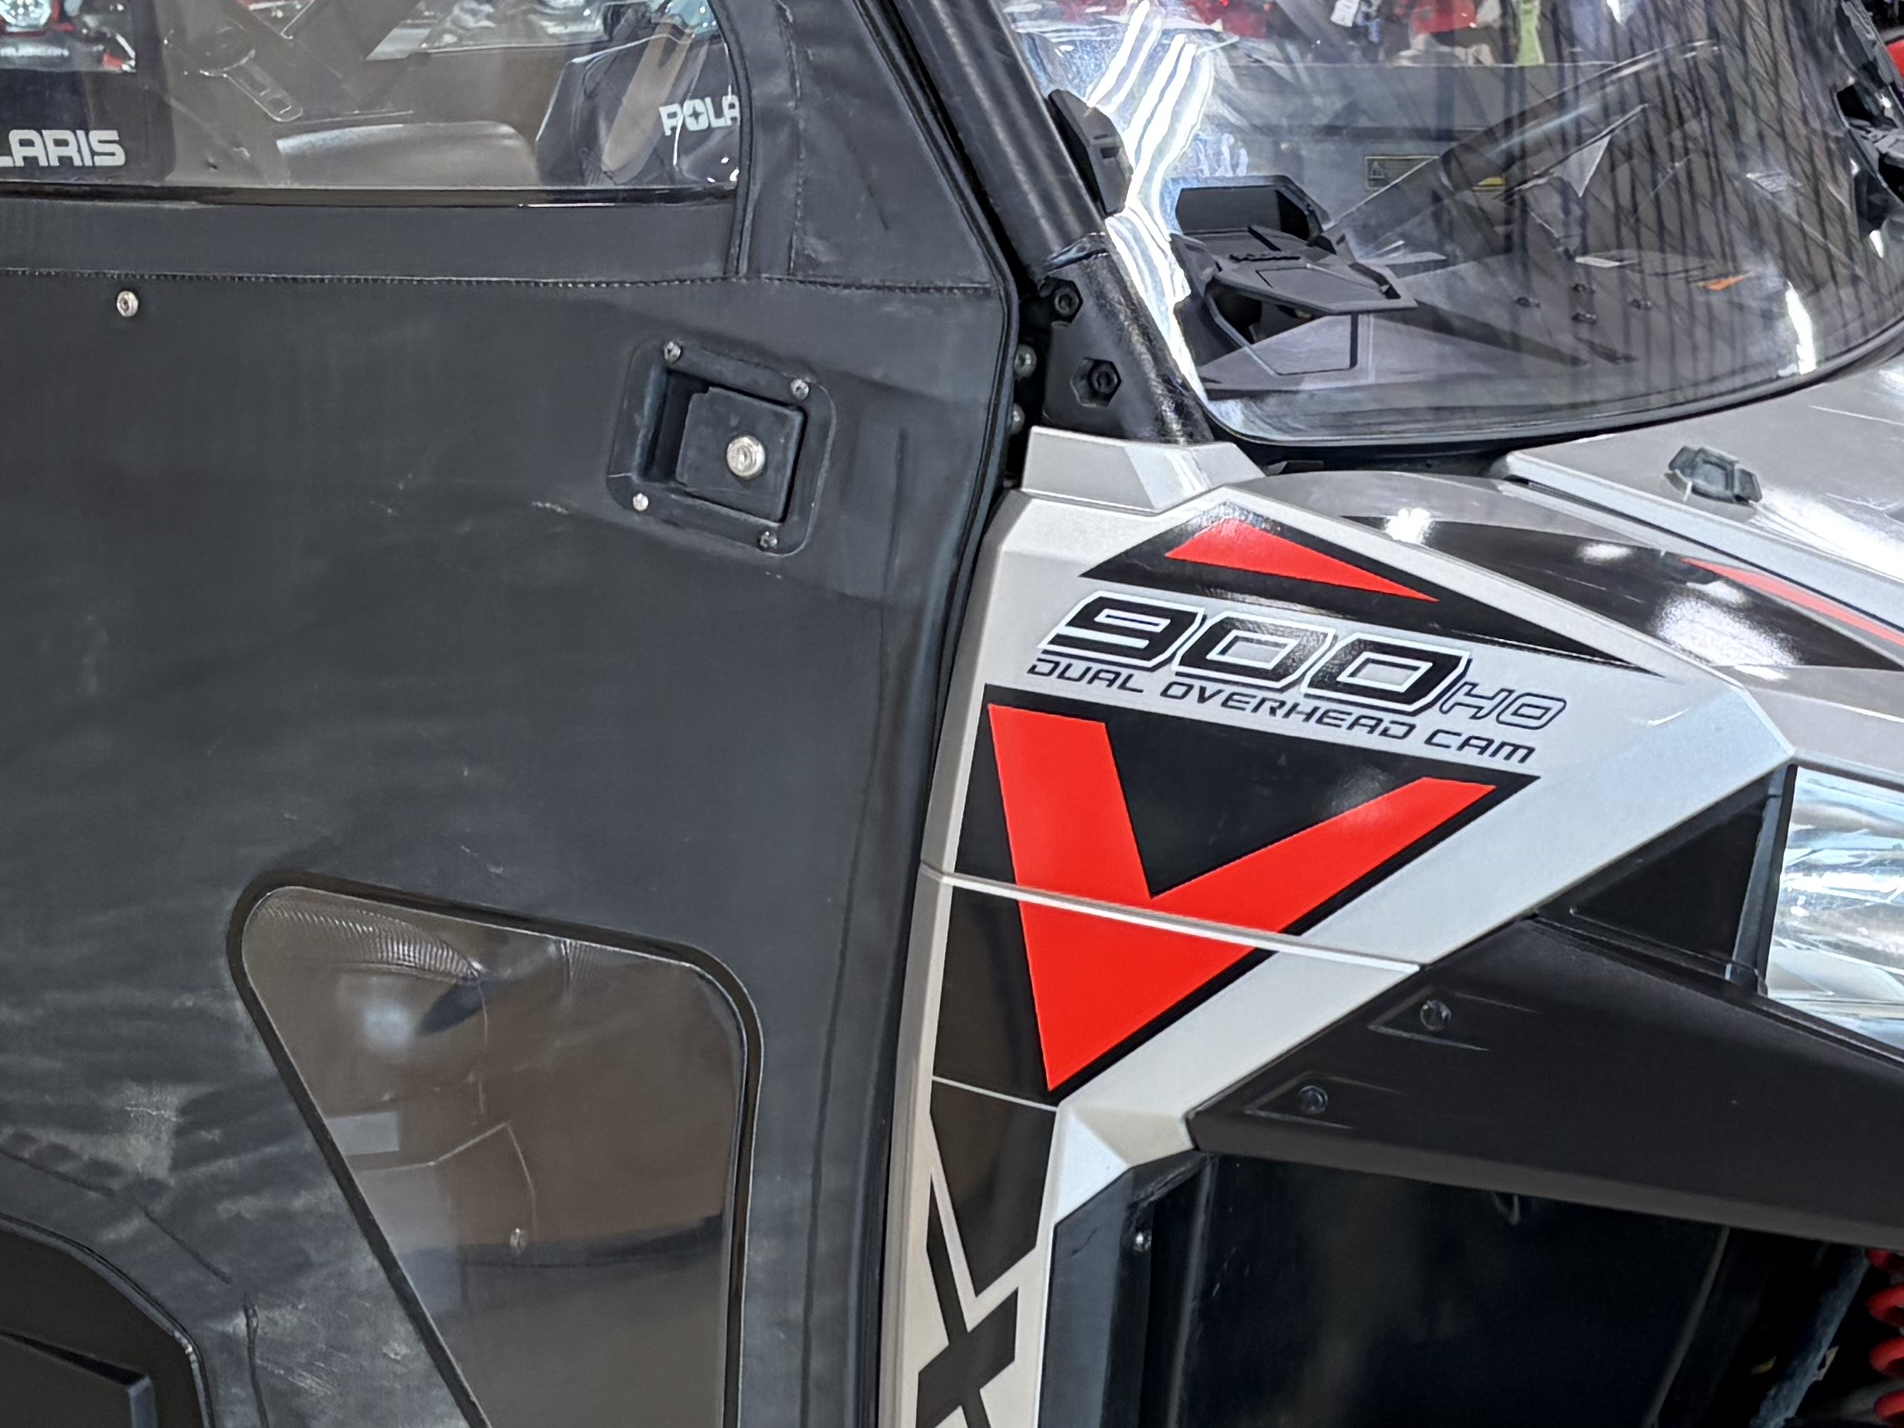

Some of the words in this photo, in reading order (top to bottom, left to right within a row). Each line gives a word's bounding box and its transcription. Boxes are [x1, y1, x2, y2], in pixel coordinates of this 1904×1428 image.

[659, 94, 740, 136] POLA
[1027, 656, 1144, 694] DUAL
[1160, 680, 1416, 741] OVERHEAD
[1424, 729, 1536, 764] CAM
